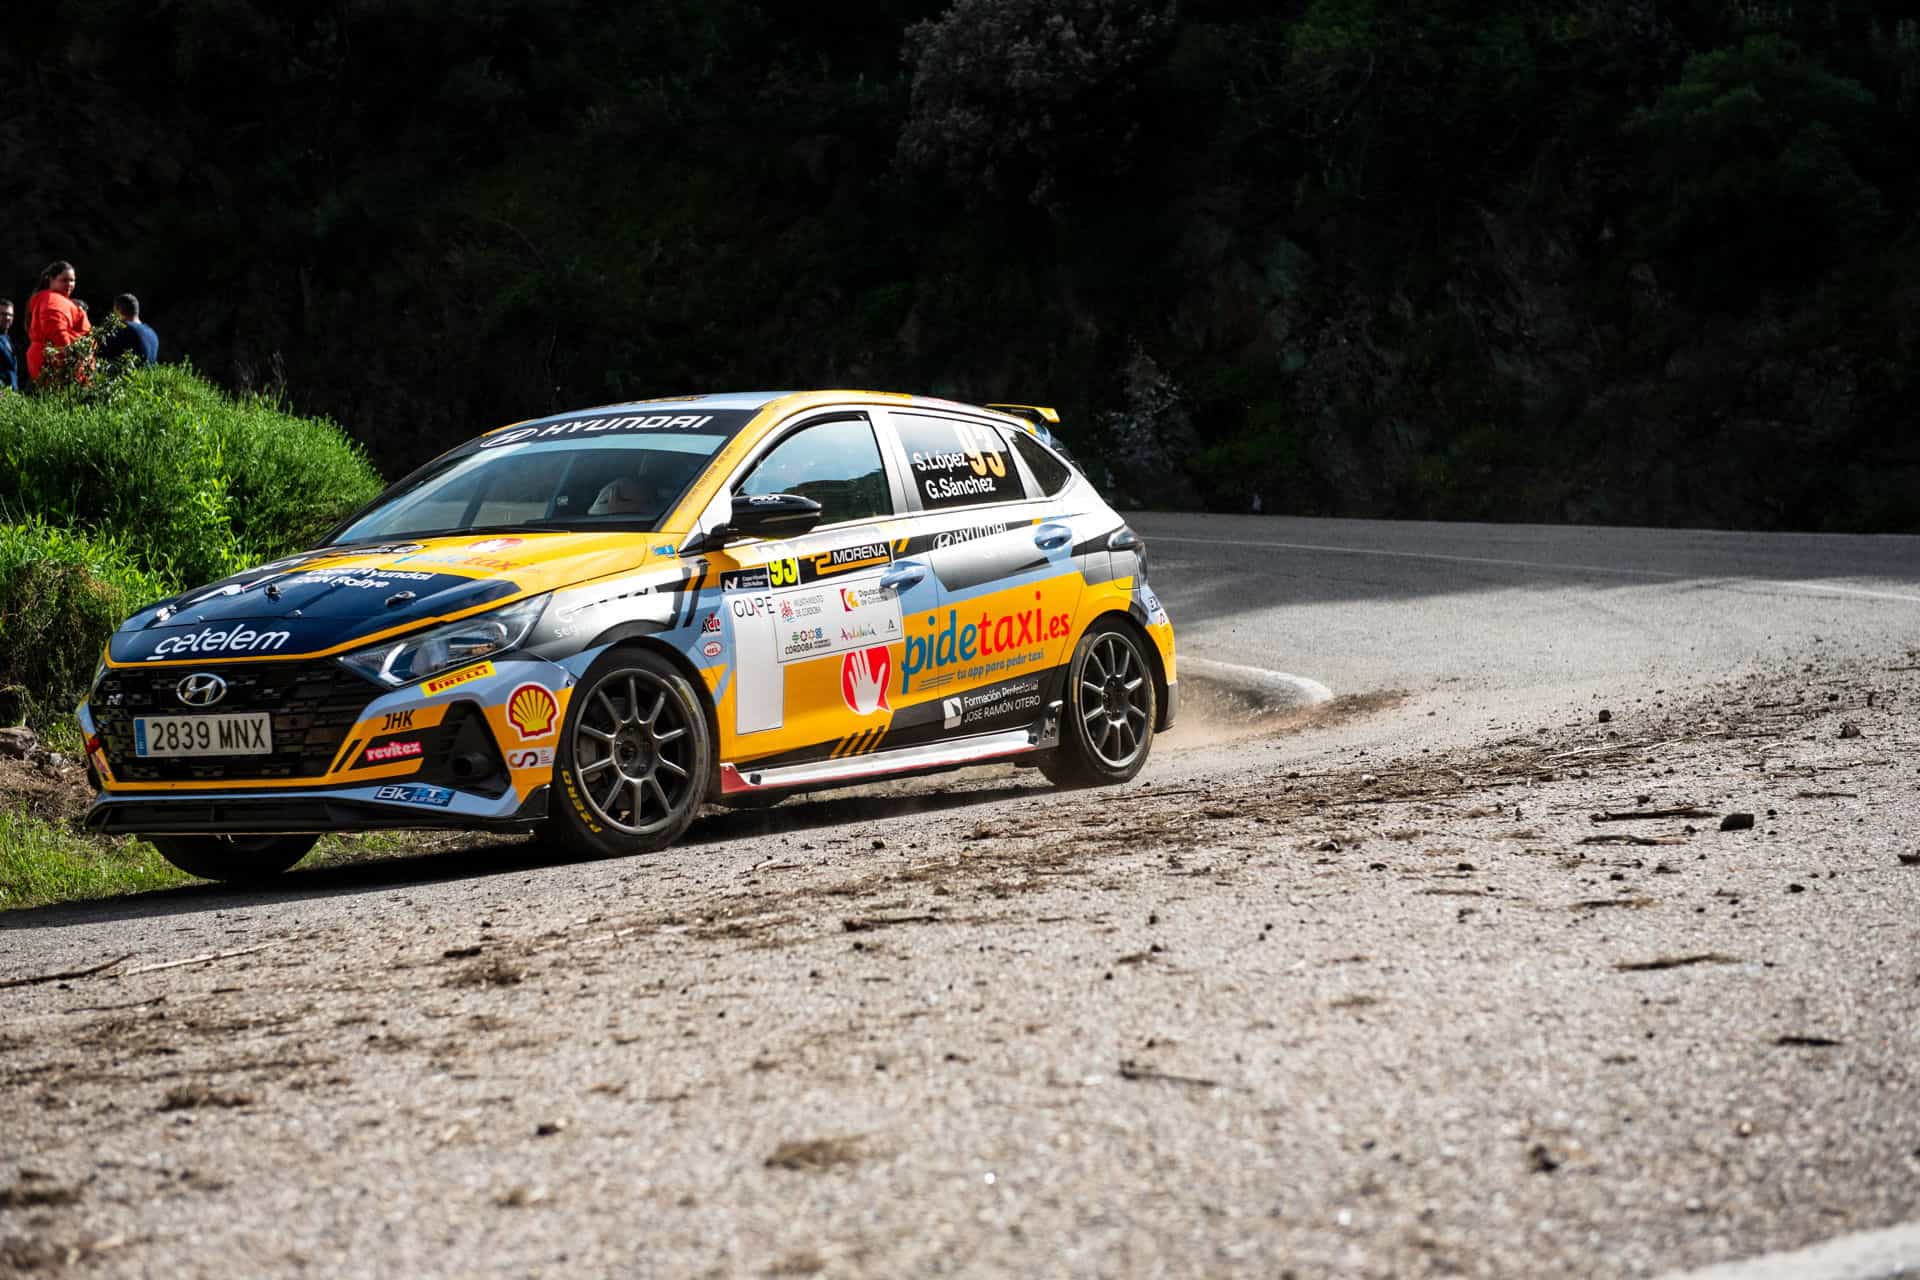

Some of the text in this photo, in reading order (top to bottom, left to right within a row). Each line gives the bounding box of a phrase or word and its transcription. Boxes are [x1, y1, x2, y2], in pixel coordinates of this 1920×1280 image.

[538, 415, 714, 437] HYUNDAI
[925, 475, 997, 500] G.Sánchez
[833, 542, 889, 564] MORENA
[901, 591, 1071, 695] pidetaxi.es
[427, 663, 490, 693] PIRELLI
[1014, 695, 1041, 710] OTERO
[381, 709, 416, 732] JHK
[151, 718, 266, 751] 2839 MNX
[366, 741, 422, 761] revitex
